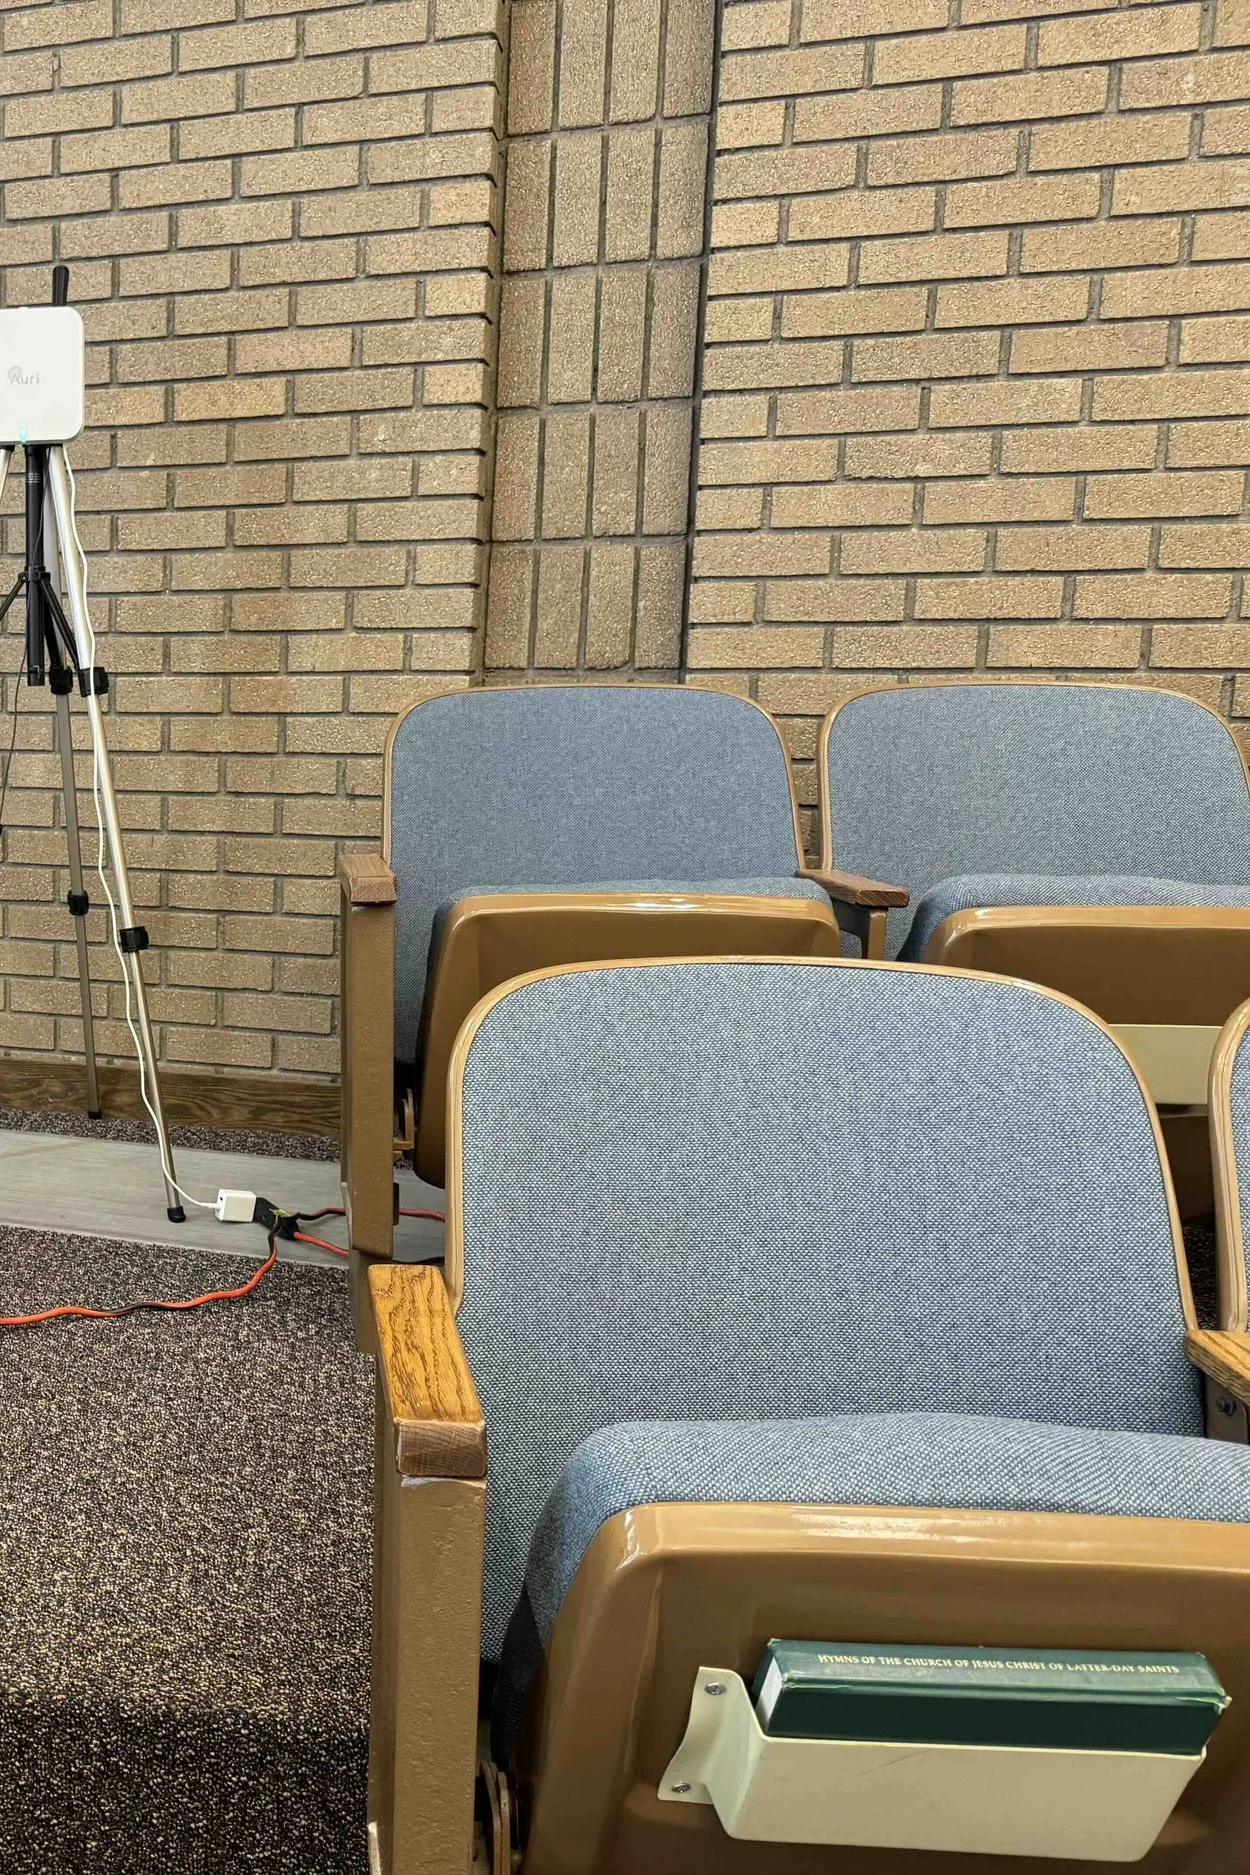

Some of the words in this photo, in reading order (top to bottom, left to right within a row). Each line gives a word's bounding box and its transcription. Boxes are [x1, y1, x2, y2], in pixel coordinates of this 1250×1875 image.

[9, 371, 40, 385] Auri
[818, 1654, 860, 1664] HYMNS
[861, 1656, 876, 1665] OF
[878, 1656, 902, 1666] THE
[903, 1657, 953, 1667] CHURCH
[954, 1659, 969, 1668] OF
[971, 1660, 1004, 1669] JESUS
[1005, 1661, 1046, 1670] CHRIST
[1048, 1662, 1064, 1671] OF
[1066, 1663, 1135, 1673] LATTER-DAY
[1137, 1665, 1180, 1674] SAINTS
